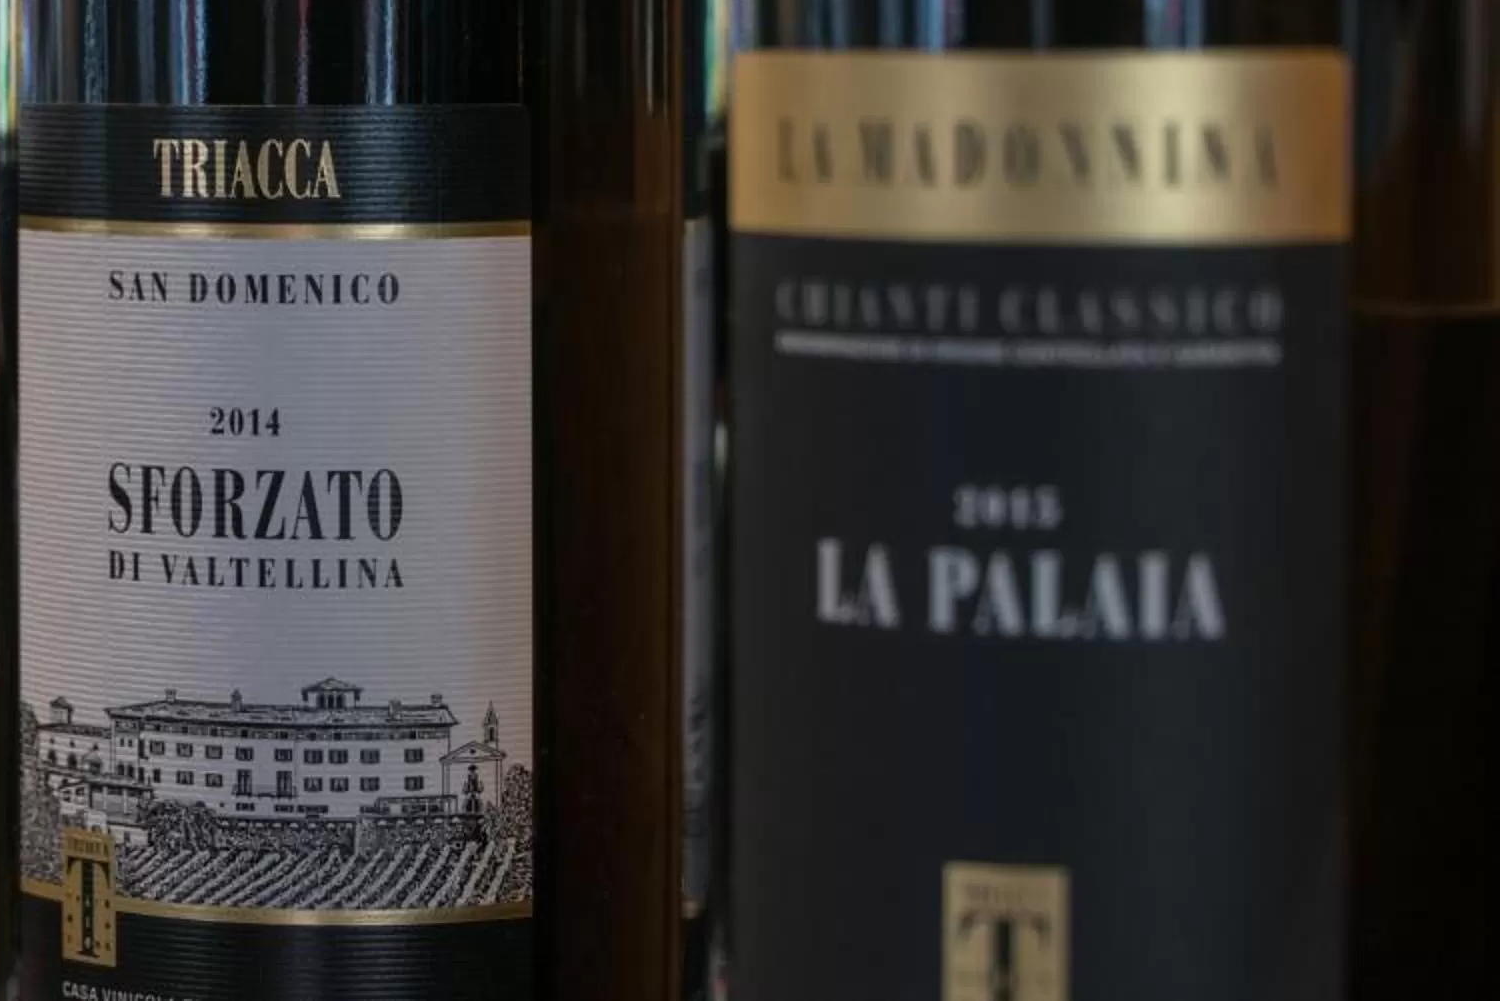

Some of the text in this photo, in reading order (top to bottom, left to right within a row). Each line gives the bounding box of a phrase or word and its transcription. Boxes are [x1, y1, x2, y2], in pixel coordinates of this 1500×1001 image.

[153, 138, 341, 199] TRIACCA
[107, 270, 400, 306] SAN DOMENICO
[209, 406, 281, 437] 2014
[107, 462, 404, 541] SFORZATO
[108, 550, 405, 589] DI VALTELLINA
[816, 536, 1227, 642] LA PALAIA
[62, 980, 176, 1001] CASA VINIC
